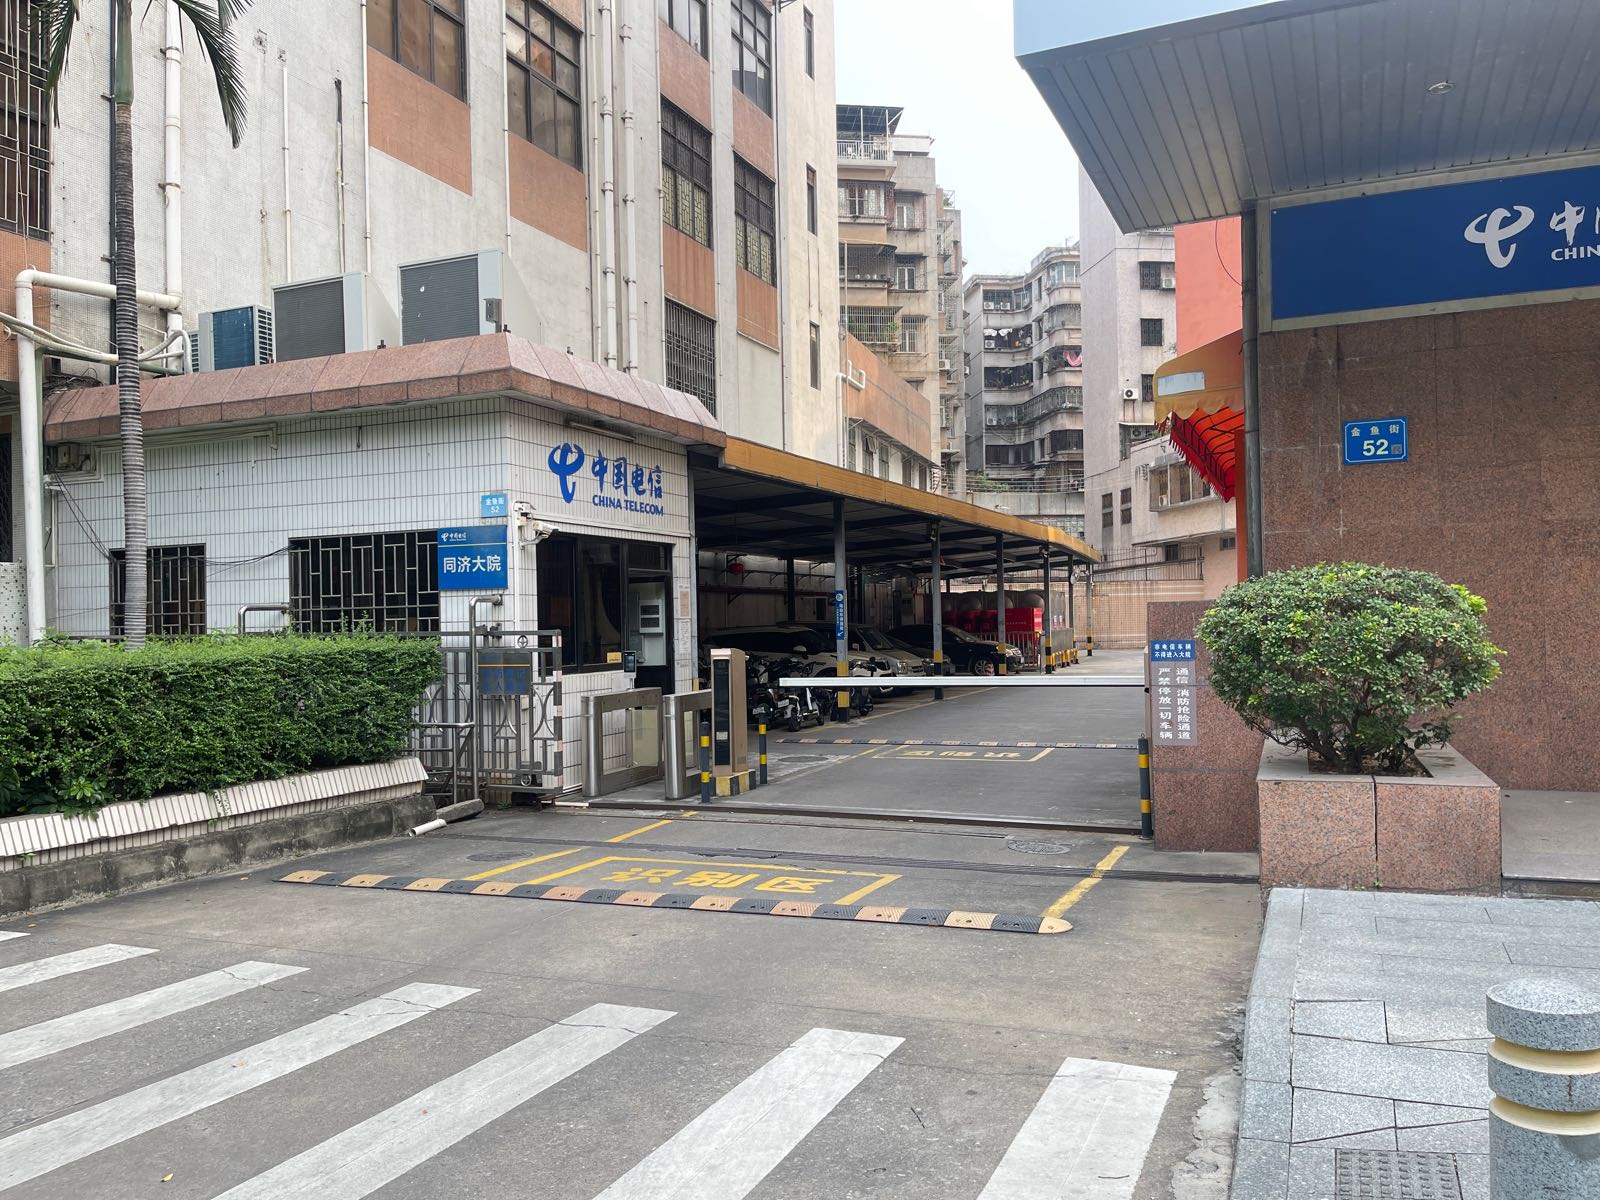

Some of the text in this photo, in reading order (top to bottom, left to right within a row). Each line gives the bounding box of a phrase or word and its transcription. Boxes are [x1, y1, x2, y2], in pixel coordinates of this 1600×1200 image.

[1550, 200, 1600, 246] 中
[1351, 424, 1400, 437] 金鱼街
[1362, 439, 1389, 456] 52
[592, 449, 663, 499] 中国电信
[490, 505, 500, 513] 52
[592, 494, 664, 517] CHINA TELECOM
[443, 554, 502, 573] 同济大院
[1154, 651, 1192, 659] 不得进入大院
[1158, 667, 1173, 740] 严禁停放一切车辆
[600, 867, 834, 894] 识别区
